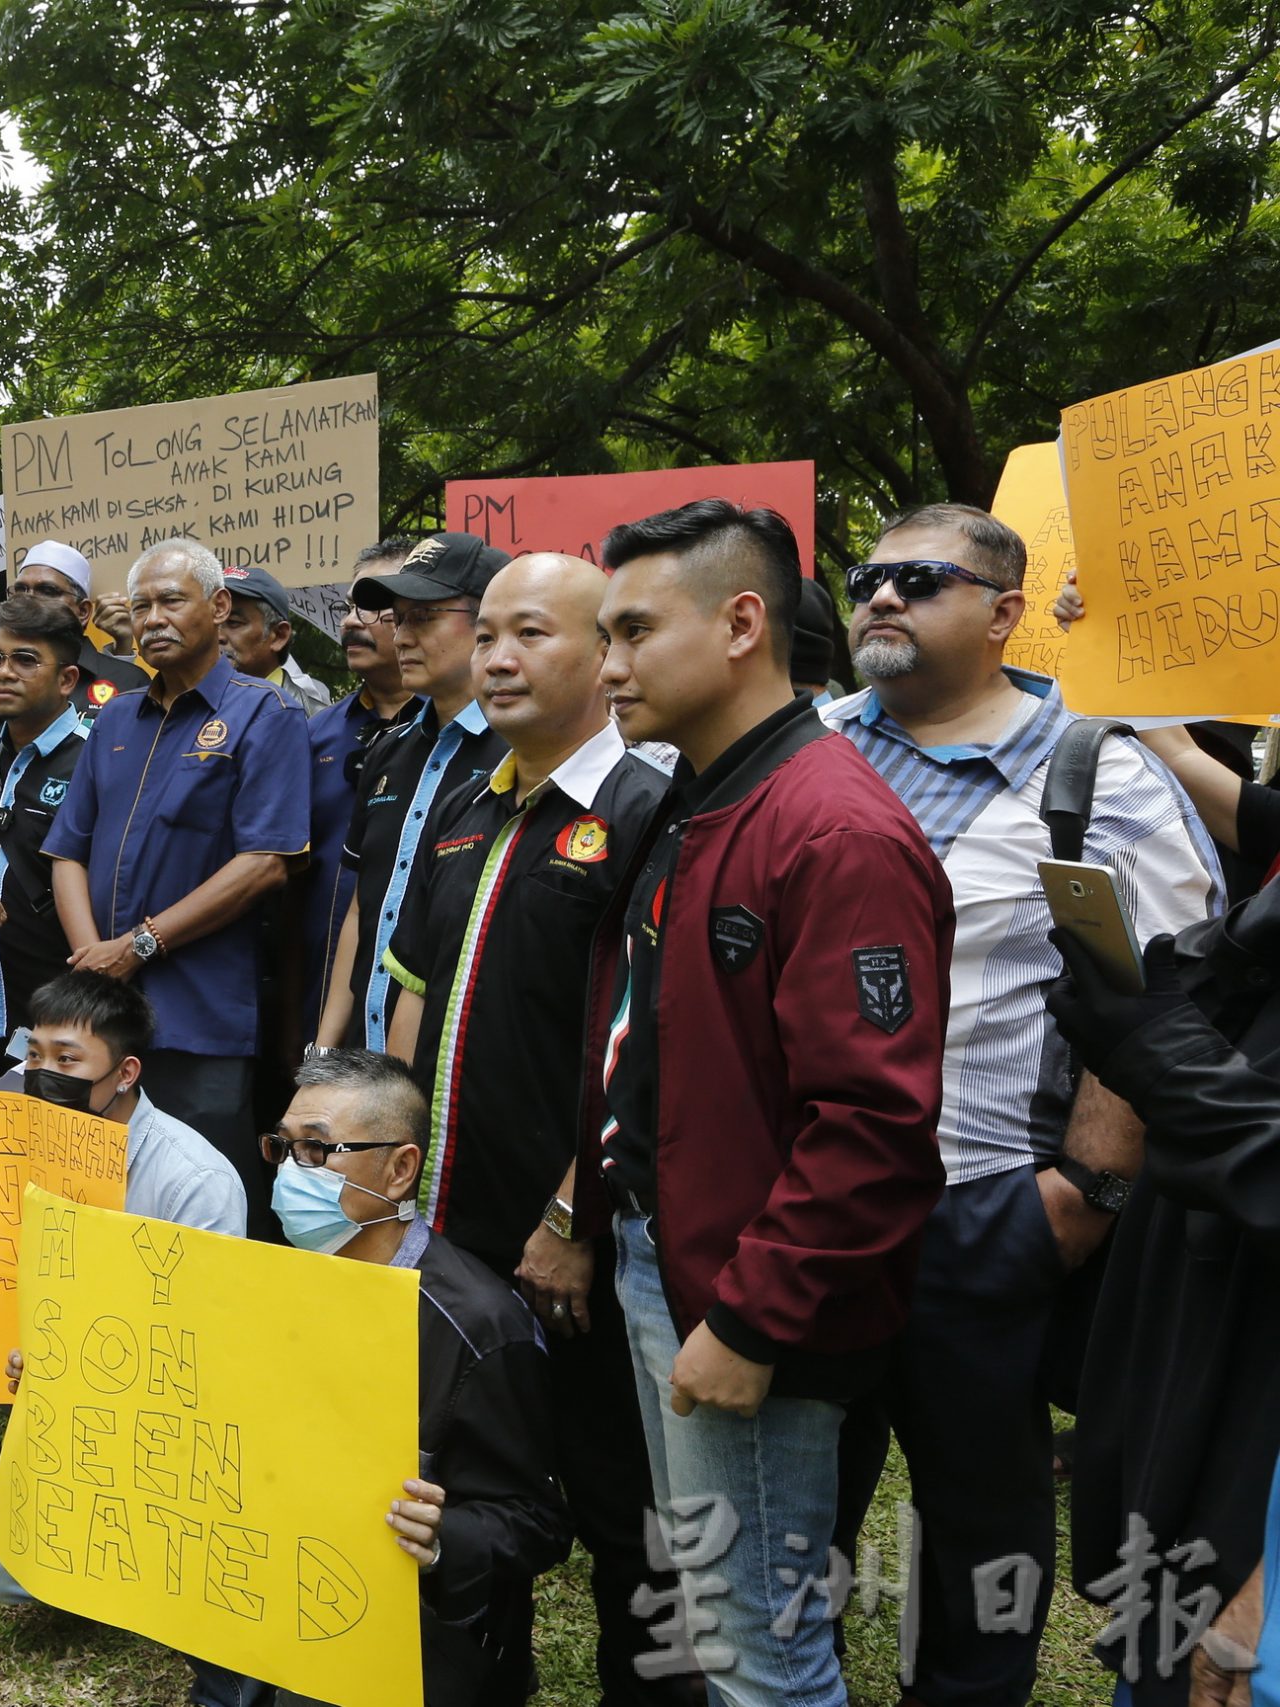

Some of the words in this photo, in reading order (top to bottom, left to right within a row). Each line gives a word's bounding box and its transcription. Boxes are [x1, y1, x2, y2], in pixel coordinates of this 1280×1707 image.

[12, 430, 72, 492] PM
[219, 395, 377, 451] SELAMATKAN
[1067, 355, 1280, 471] PULANGK
[11, 510, 56, 538] ANAK
[62, 498, 100, 529] KAMI
[213, 483, 232, 502] DI
[246, 462, 342, 497] KURUNG
[172, 456, 228, 486] ANAK
[246, 440, 305, 472] KAMI
[1119, 422, 1276, 527] ANAK
[13, 531, 128, 578] PNGKAN
[140, 522, 200, 551] ANAK
[209, 509, 258, 537] KAMI
[273, 492, 355, 528] HIDUP
[214, 537, 291, 569] HIDUP
[464, 494, 522, 547] PM
[1117, 589, 1279, 684] HIDU
[28, 1299, 199, 1410] SON
[26, 1390, 243, 1514] BEEN
[9, 1461, 368, 1641] BEATED
